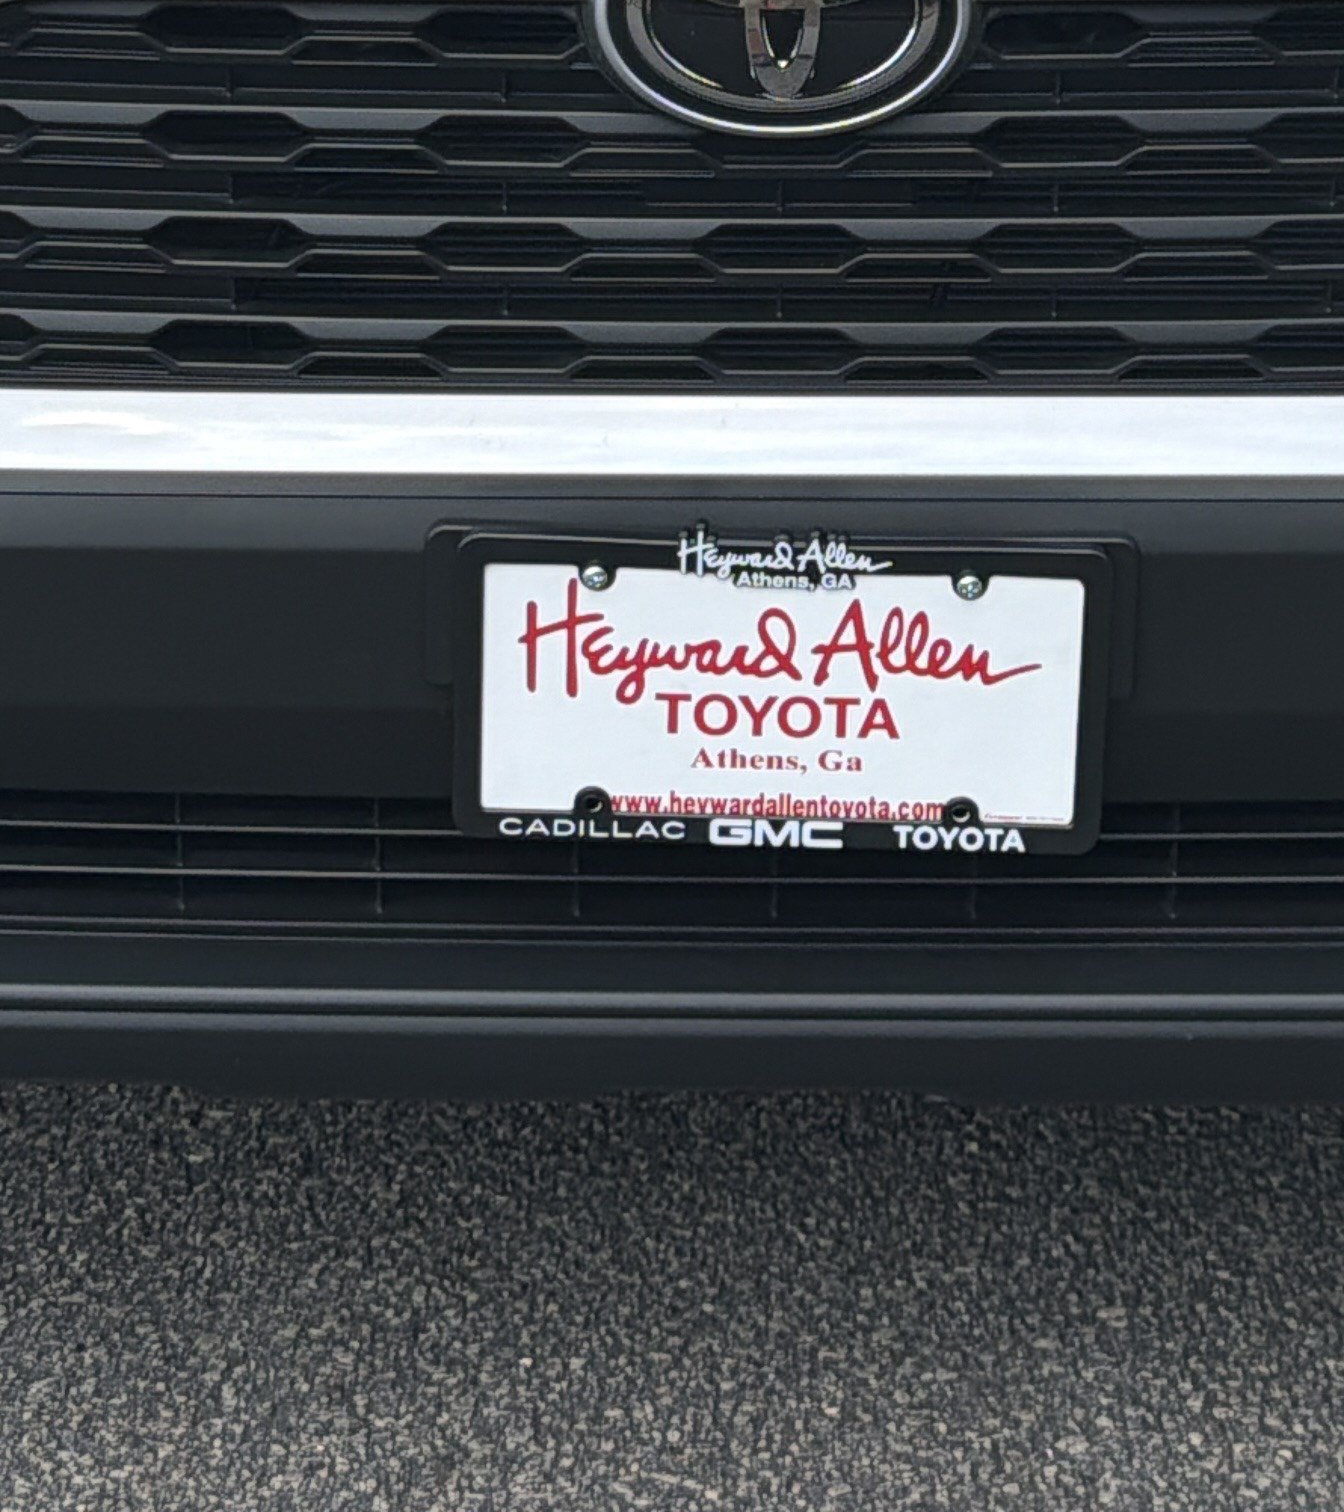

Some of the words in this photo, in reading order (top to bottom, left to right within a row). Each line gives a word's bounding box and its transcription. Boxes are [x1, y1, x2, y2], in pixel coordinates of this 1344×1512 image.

[677, 529, 795, 580] Heyward
[796, 537, 894, 575] Allen
[736, 571, 816, 592] Athens,
[821, 573, 853, 590] GA
[517, 577, 803, 705] Heyward
[811, 597, 1043, 692] Allen
[654, 692, 901, 740] TOYOTA
[690, 746, 808, 775] Athens,
[817, 748, 864, 773] Ga
[498, 816, 686, 840] CADILLAC
[708, 818, 844, 848] GMC
[892, 824, 1027, 854] TOYOTA
